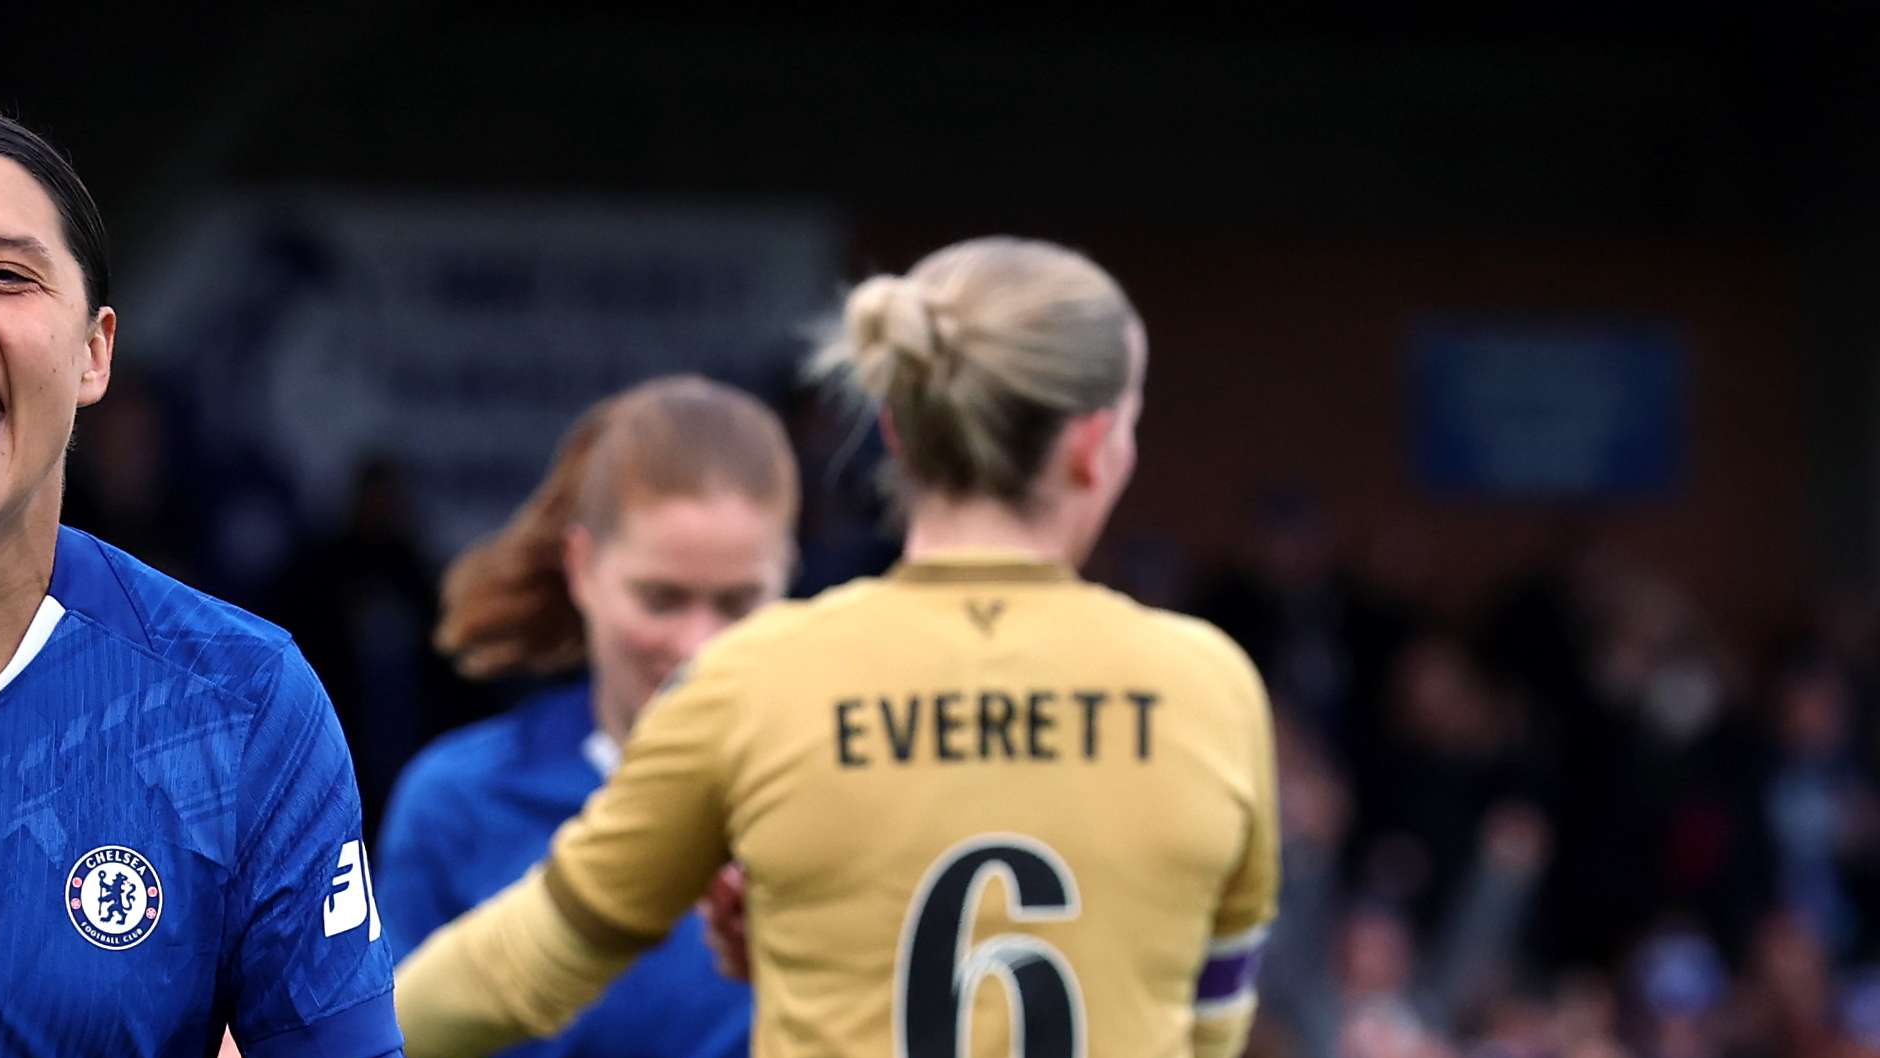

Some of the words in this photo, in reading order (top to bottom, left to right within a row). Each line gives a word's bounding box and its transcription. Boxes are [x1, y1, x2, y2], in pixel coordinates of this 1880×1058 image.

[834, 689, 1162, 767] EVERETT
[86, 850, 147, 876] CHELSEA
[80, 920, 120, 945] FOOTBALL
[123, 928, 144, 944] CLUB
